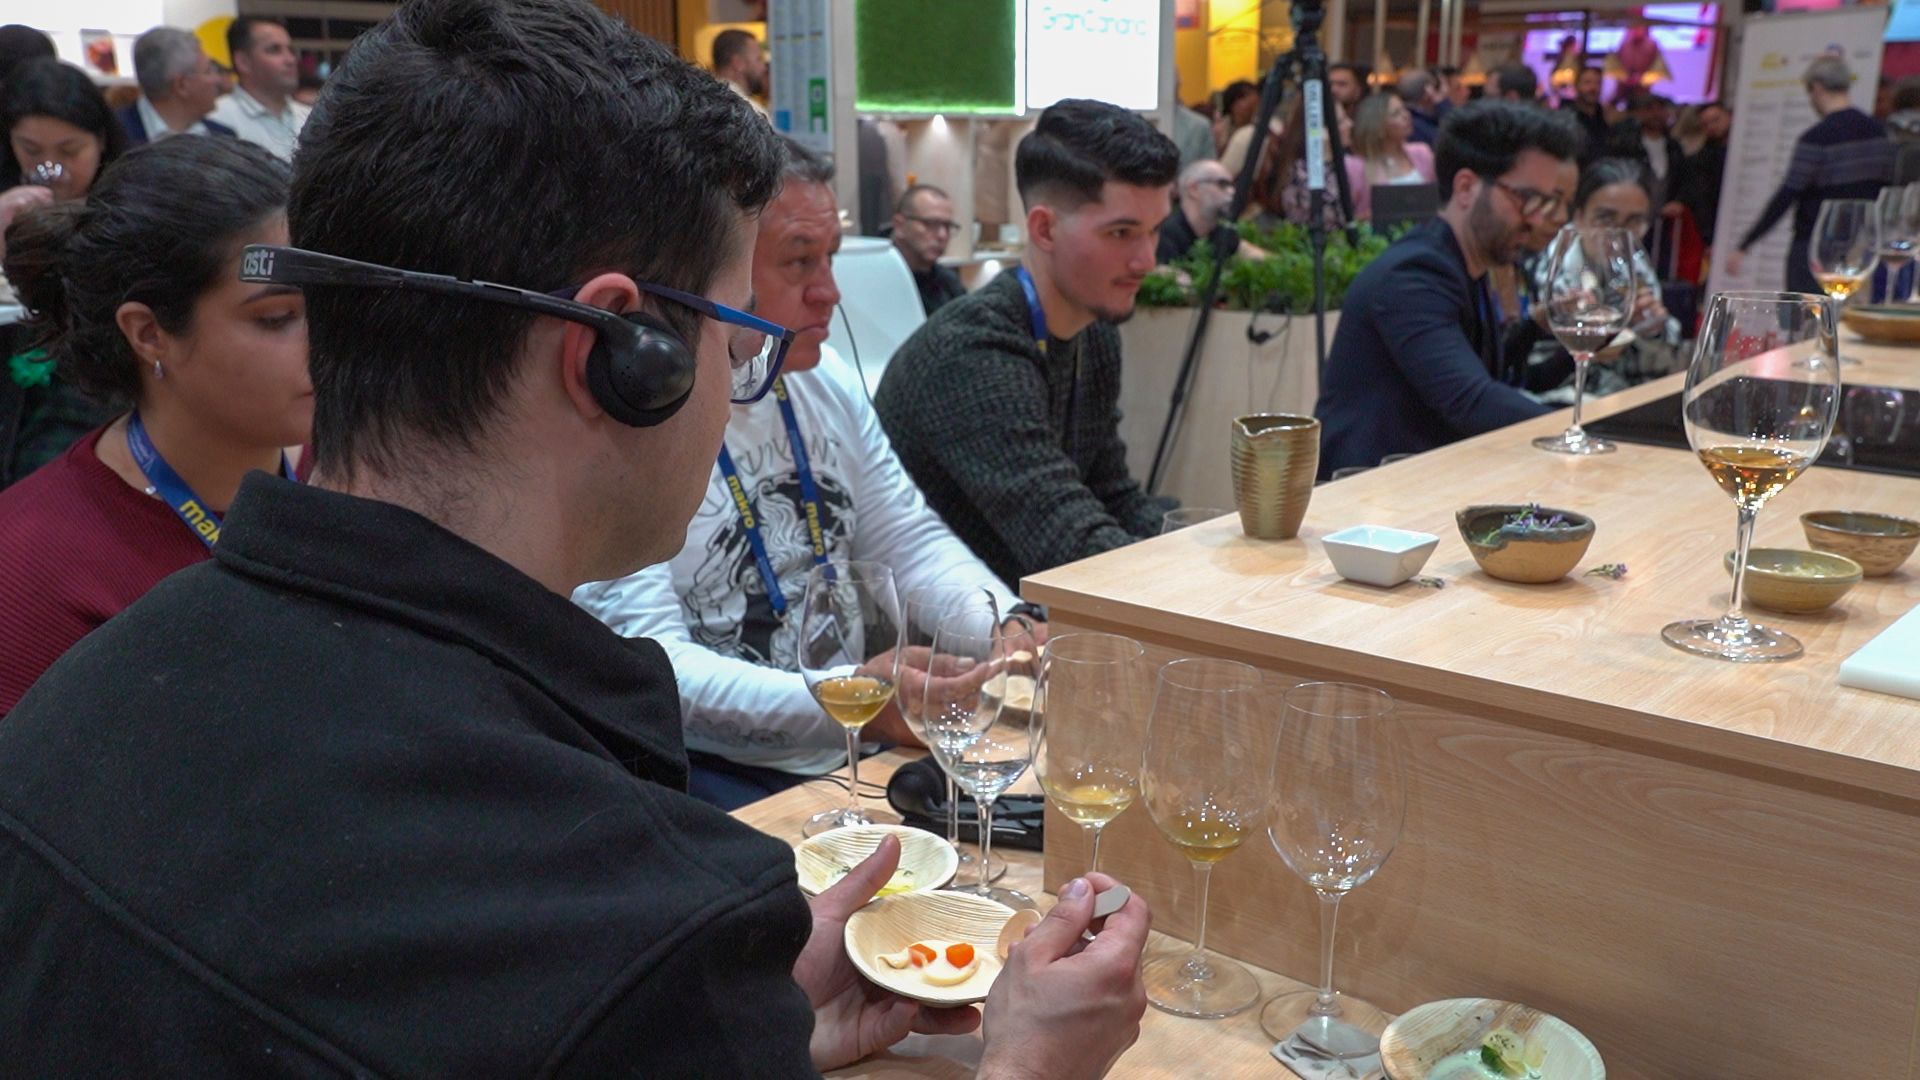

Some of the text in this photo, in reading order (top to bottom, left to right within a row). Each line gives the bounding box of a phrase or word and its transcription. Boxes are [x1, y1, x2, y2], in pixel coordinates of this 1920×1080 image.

[243, 249, 275, 276] asti
[727, 474, 756, 528] makro
[805, 502, 825, 556] makro
